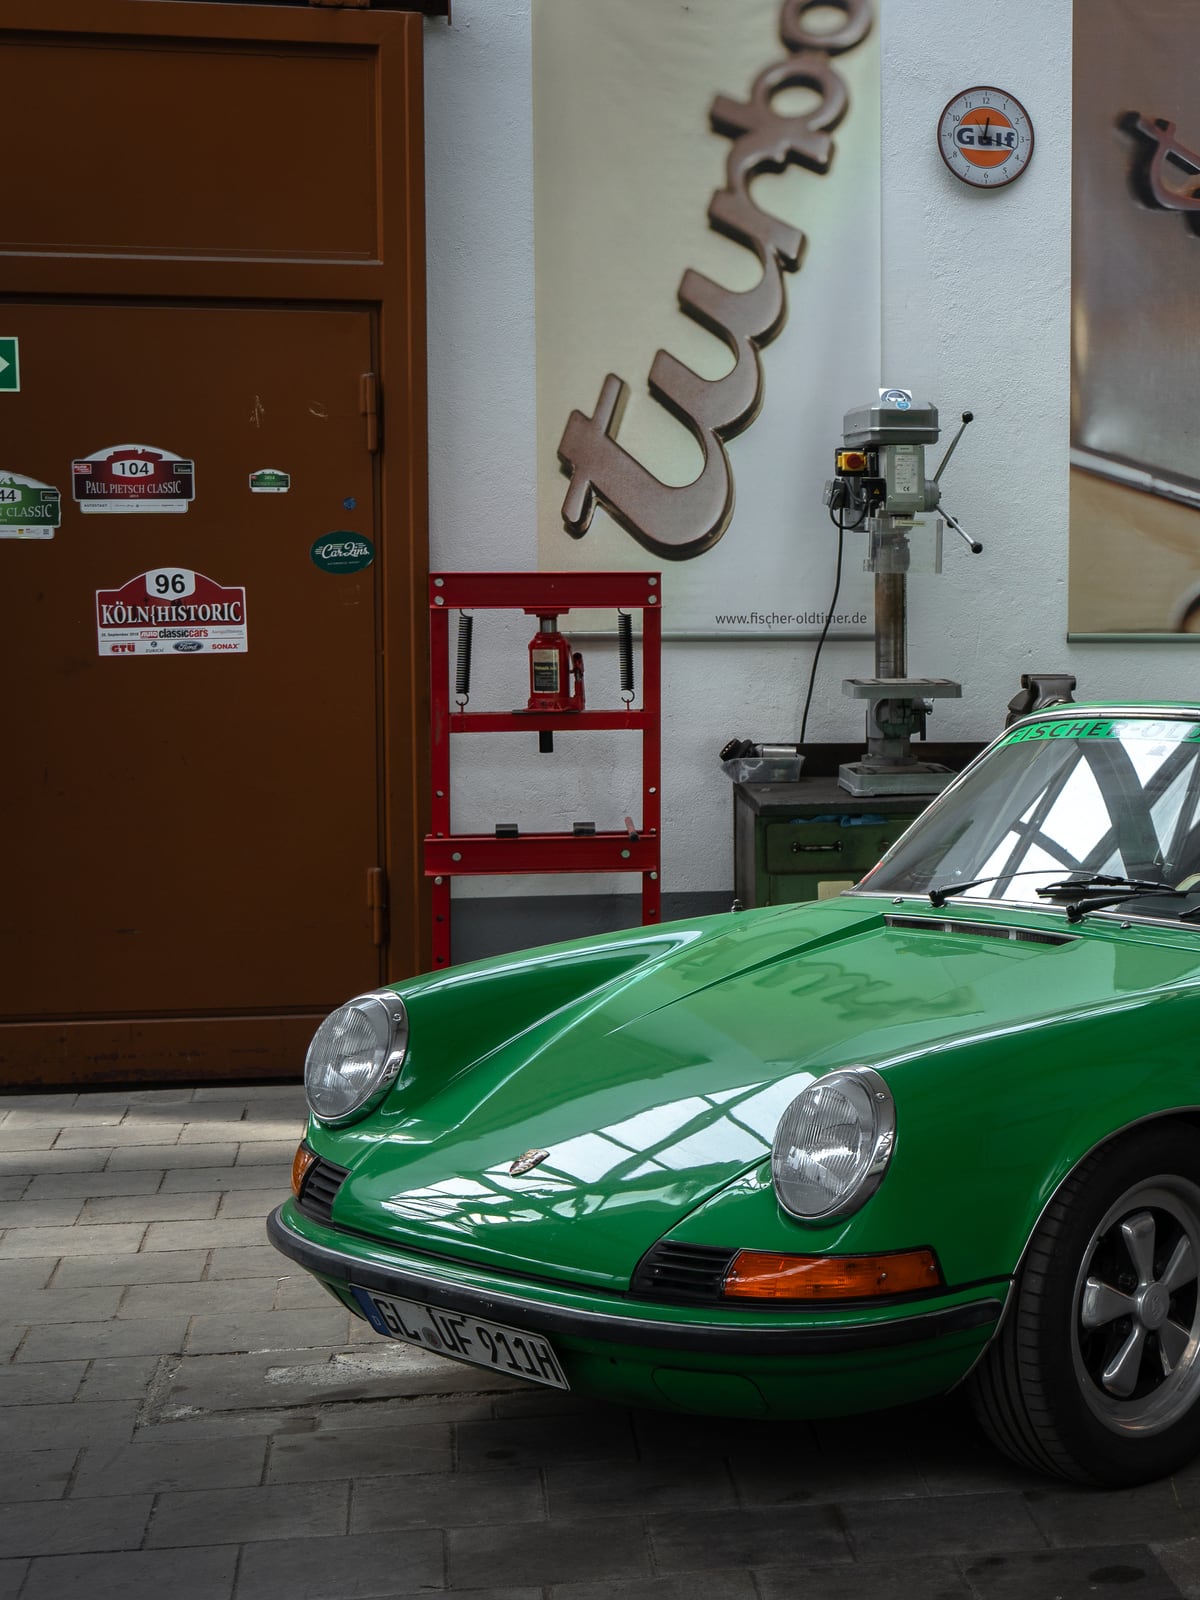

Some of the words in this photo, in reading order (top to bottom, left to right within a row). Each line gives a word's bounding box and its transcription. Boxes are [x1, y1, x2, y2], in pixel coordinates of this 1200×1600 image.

[957, 127, 1015, 147] Gulf
[558, 0, 874, 562] turbo
[120, 463, 149, 475] 104
[85, 481, 108, 494] PAUL
[110, 483, 145, 494] PIETSCH
[147, 480, 181, 494] CLASSIC
[6, 503, 52, 517] CLASSIC
[155, 573, 185, 594] 96
[715, 612, 867, 625] www.fischer-oldtimer.de
[373, 1298, 421, 1341] GL
[427, 1307, 472, 1355] UF
[476, 1326, 563, 1383] 911H
